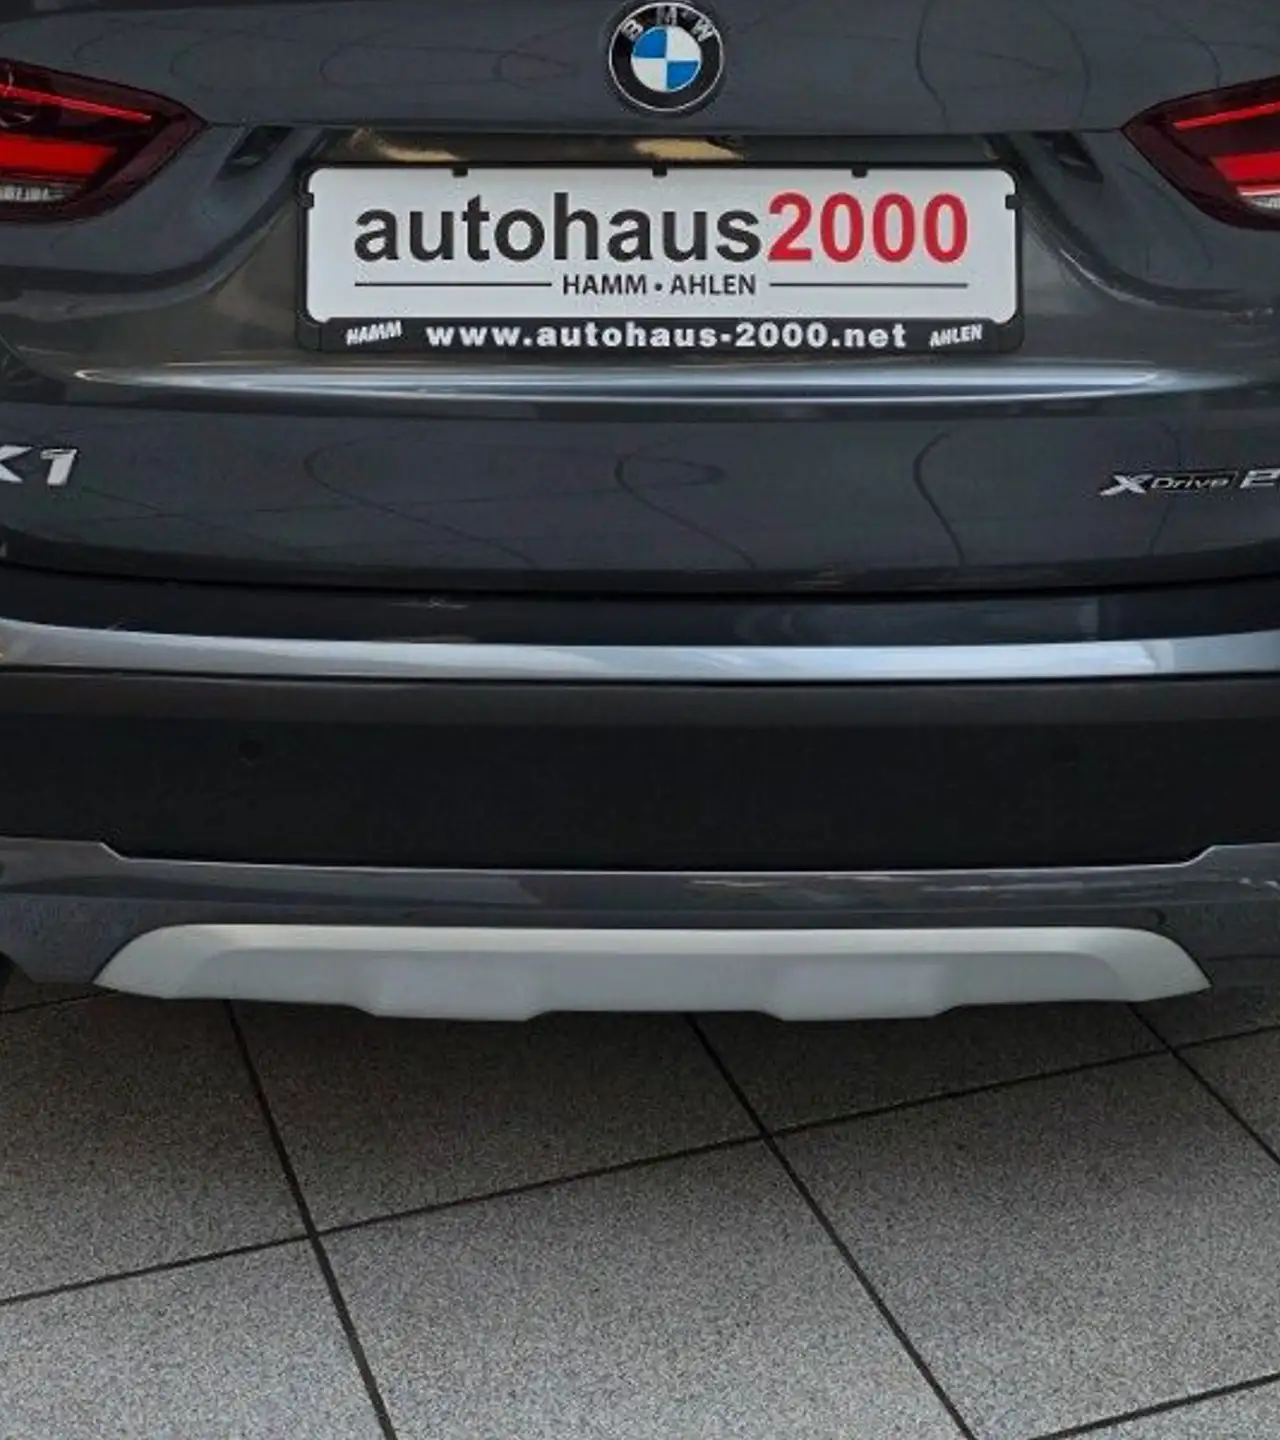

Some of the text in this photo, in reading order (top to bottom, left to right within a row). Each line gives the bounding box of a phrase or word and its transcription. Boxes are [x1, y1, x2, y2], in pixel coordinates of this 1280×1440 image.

[353, 191, 969, 264] autohaus2000
[562, 273, 757, 296] HAMM AHLEN
[345, 319, 403, 346] HAMM
[424, 321, 908, 349] www.autohaus-2000.net
[928, 323, 984, 349] AHLEN
